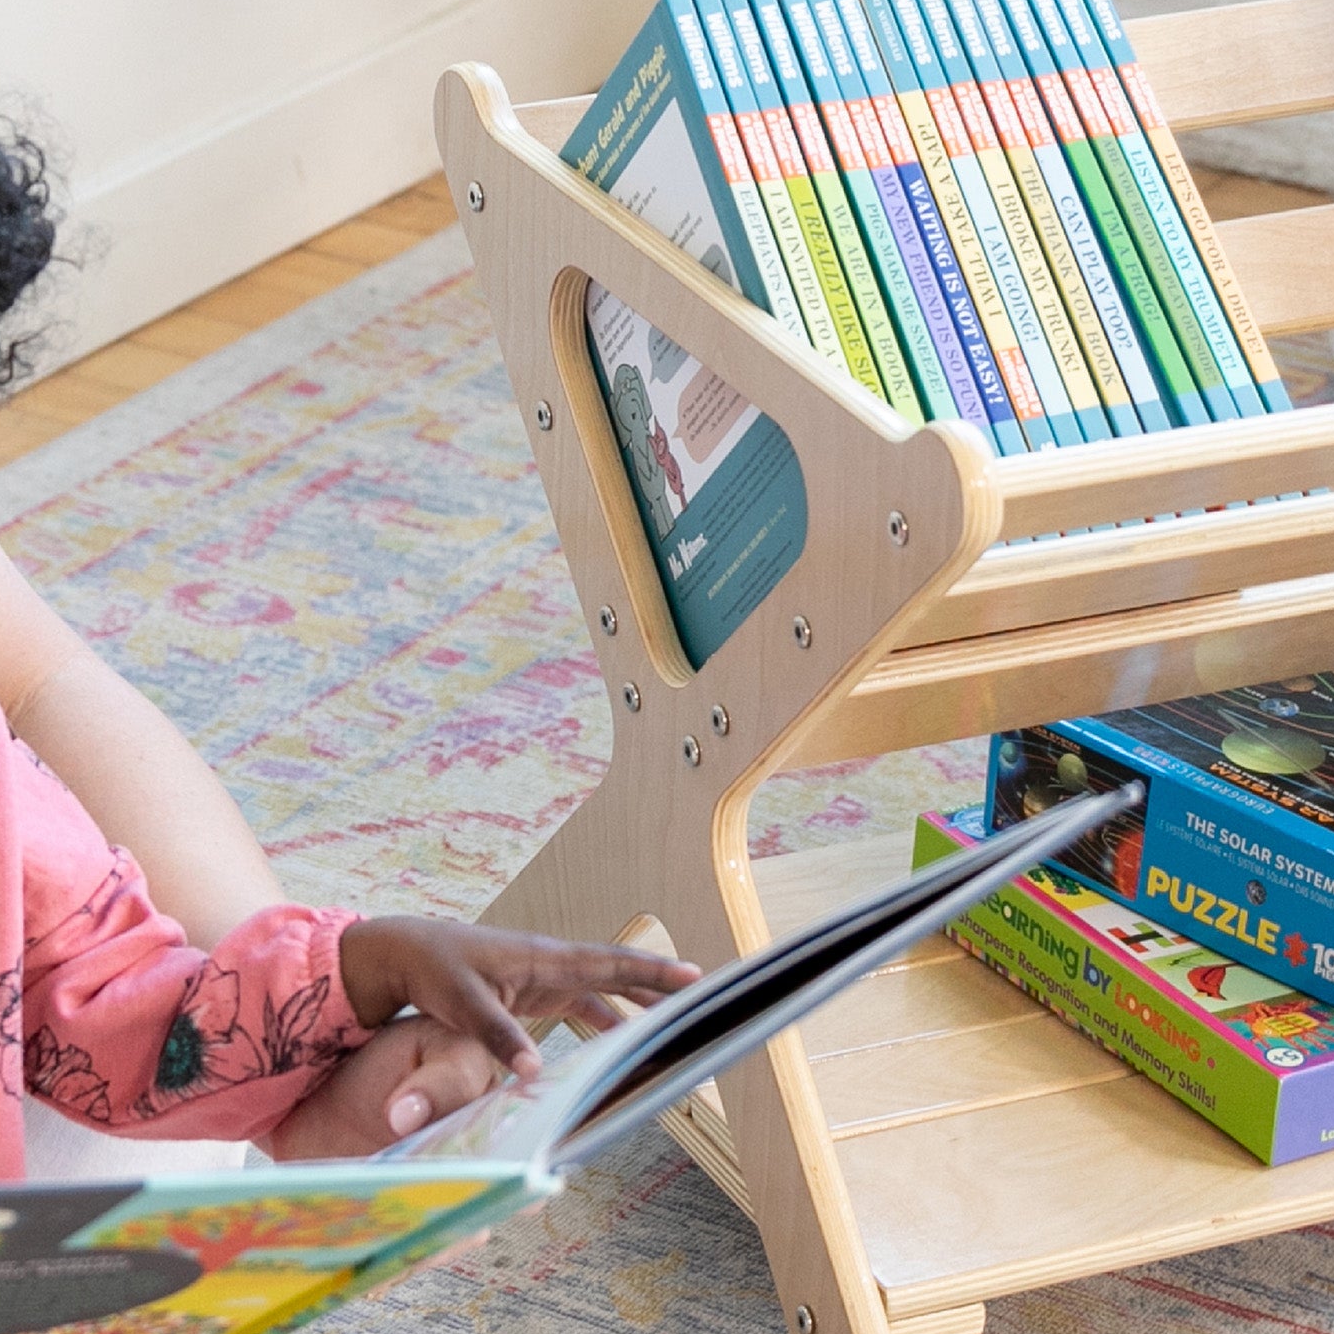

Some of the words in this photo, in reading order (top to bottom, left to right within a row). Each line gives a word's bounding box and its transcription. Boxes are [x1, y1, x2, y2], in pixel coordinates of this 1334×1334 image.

[677, 14, 714, 90] Willems
[706, 12, 743, 87] Willems
[733, 8, 769, 85] Willems
[761, 4, 797, 79] Willems
[790, 3, 827, 78] Willems
[815, 0, 852, 76] Willems
[597, 101, 626, 149] Gerald
[624, 77, 642, 112] and
[638, 44, 667, 90] Piggie
[917, 122, 944, 168] NAP!
[770, 190, 781, 198] I
[938, 175, 954, 187] A
[997, 182, 1009, 191] I
[1060, 195, 1086, 232] CAN
[740, 189, 783, 291] ELEPHANTS
[774, 205, 794, 239] AM
[909, 178, 954, 269] WAITING
[944, 192, 975, 248] TAKE
[984, 225, 998, 233] I
[990, 239, 1010, 268] AM
[1001, 197, 1038, 262] BROKE
[1076, 237, 1091, 246] I
[1165, 152, 1196, 203] LET'S
[1188, 207, 1208, 232] GO
[1201, 236, 1227, 272] FOR
[1219, 276, 1233, 289] A
[1226, 290, 1265, 357] DRIVE!
[786, 239, 820, 311] INVITED
[800, 200, 813, 208] I
[807, 217, 845, 296] REALLY
[834, 300, 864, 348] LIKE
[879, 169, 903, 199] MY
[892, 206, 920, 248] NEW
[909, 253, 946, 322] FRIEND
[936, 326, 954, 345] IS
[945, 350, 964, 372] SO
[958, 378, 984, 421] FUN!
[942, 274, 964, 294] IS
[968, 251, 1000, 305] WILL
[1020, 166, 1047, 205] THE
[1037, 210, 1076, 279] THANK
[1067, 282, 1094, 321] YOU
[1086, 330, 1118, 387] BOOK
[1030, 267, 1053, 295] MY
[1081, 251, 1114, 296] PLAY
[1102, 139, 1122, 167] ARE
[1117, 170, 1136, 203] YOU
[1131, 201, 1159, 249] READY
[1153, 252, 1169, 271] TO
[1162, 272, 1186, 314] PLAY
[1181, 314, 1219, 382] OUTSIDE?
[1102, 208, 1126, 243] I'M
[1125, 262, 1160, 323] FROG!
[1130, 149, 1168, 212] LISTEN
[1161, 219, 1180, 242] TO
[1172, 247, 1193, 272] MY
[1188, 276, 1237, 371] TRUMPET!
[814, 319, 832, 341] TO
[832, 204, 855, 237] WE
[845, 246, 872, 285] ARE
[860, 291, 879, 312] IN
[878, 339, 911, 401] BOOK!
[867, 203, 888, 240] PIGS
[881, 246, 907, 288] MAKE
[898, 295, 919, 320] ME
[912, 324, 945, 396] SNEEZE!
[951, 298, 980, 339] NOT
[1003, 273, 1040, 343] GOING!
[1103, 300, 1133, 350] TOO?
[1042, 301, 1080, 374] TRUNK!
[972, 344, 1006, 406] EASY!
[1209, 764, 1296, 807] SYSTEM
[1186, 811, 1217, 839] THE
[1219, 828, 1272, 864] SOLAR
[1146, 865, 1281, 955] PUZZLE
[1017, 949, 1092, 1018] Recognition
[1093, 1008, 1120, 1039] and
[1121, 1028, 1176, 1081] Memory
[1178, 1072, 1217, 1112] Skills!
